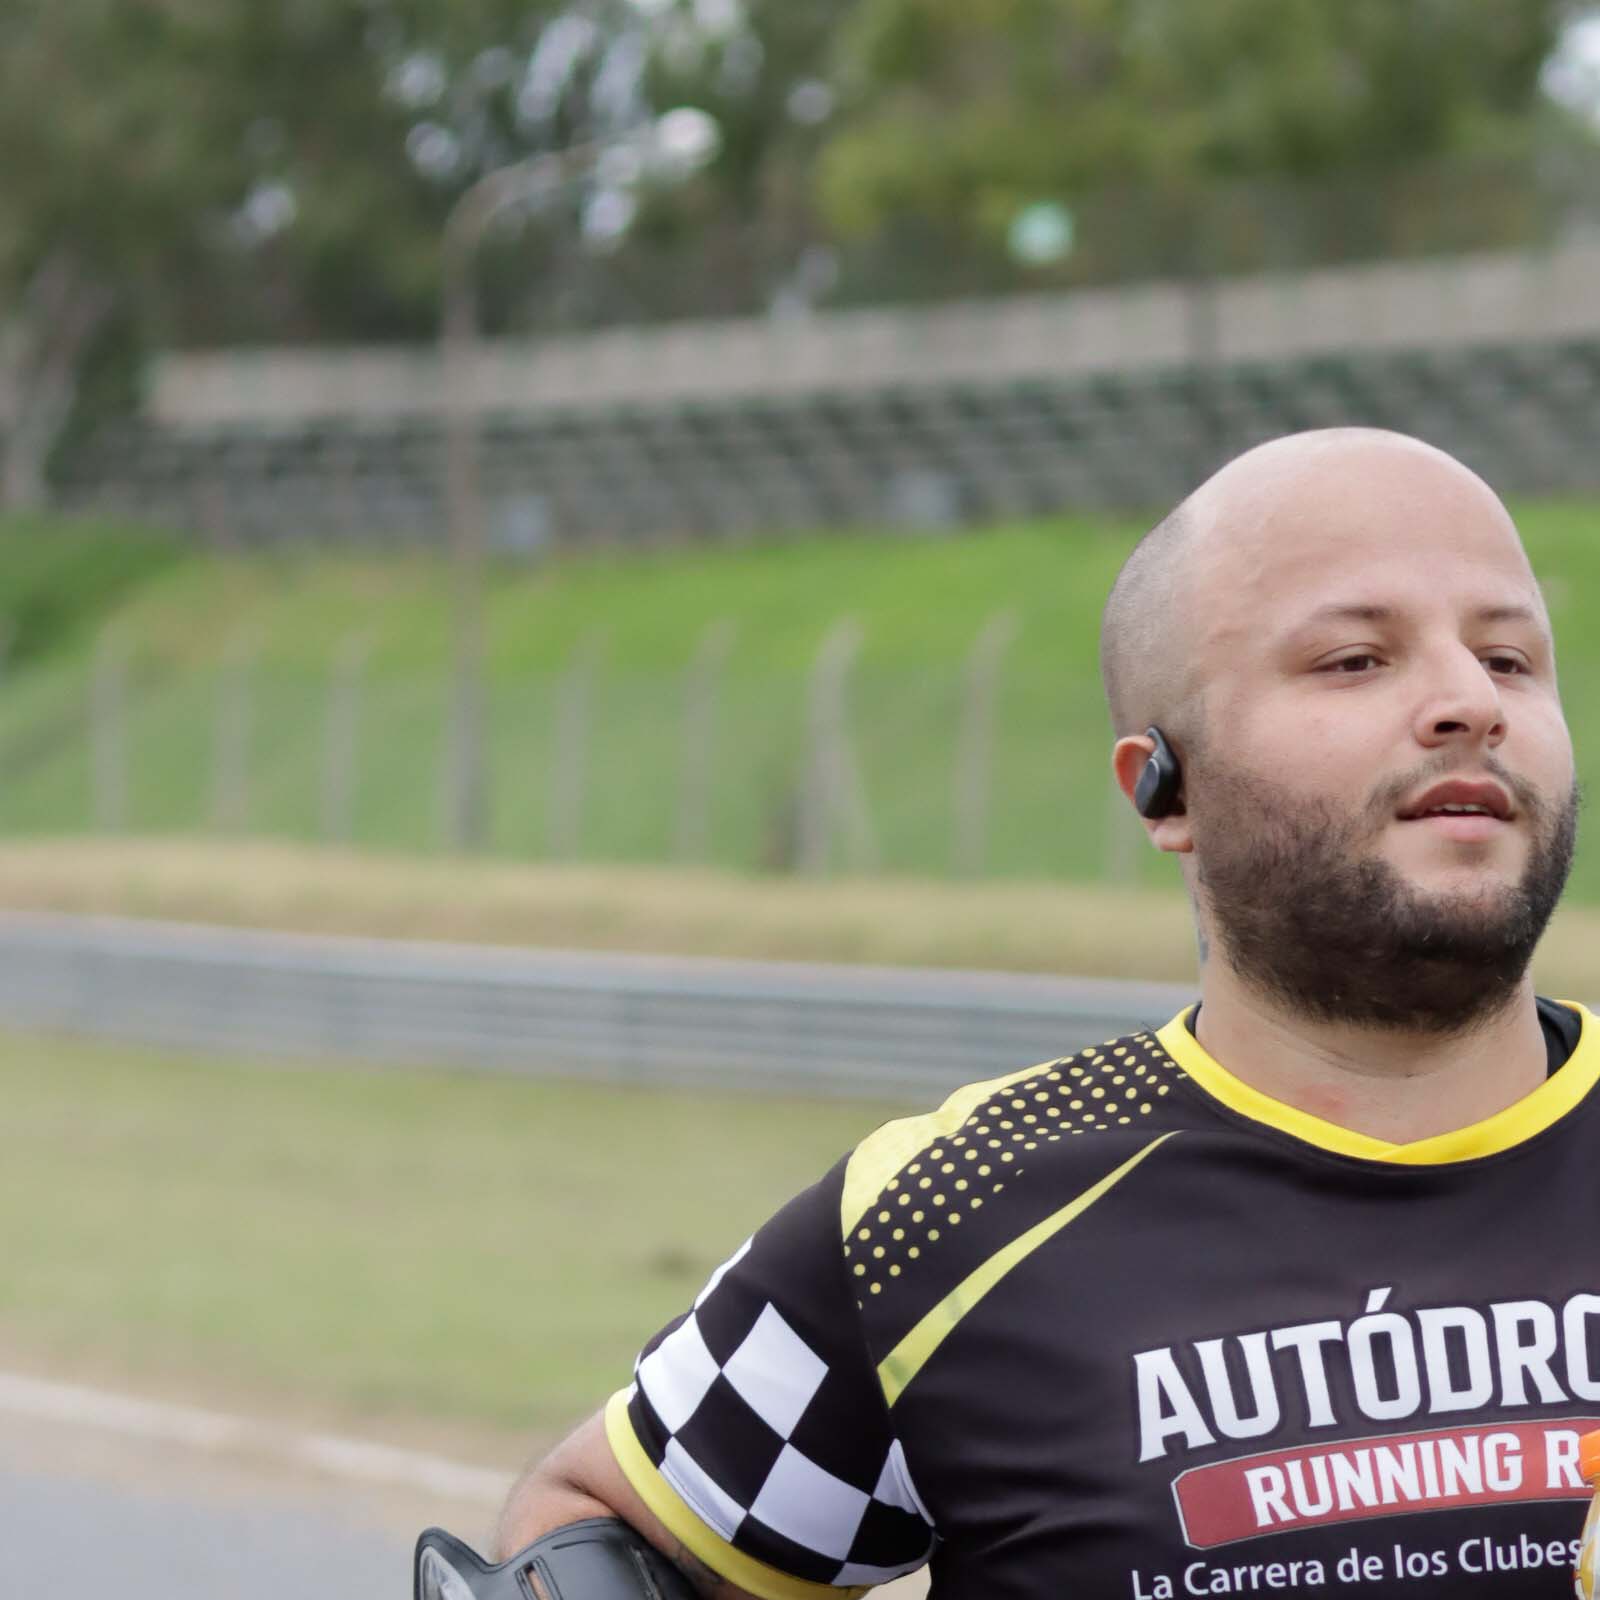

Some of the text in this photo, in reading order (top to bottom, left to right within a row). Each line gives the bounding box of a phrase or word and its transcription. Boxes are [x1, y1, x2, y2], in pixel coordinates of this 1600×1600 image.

[1244, 1432, 1523, 1528] RUNNING
[1183, 1559, 1326, 1596] Carrera
[1336, 1547, 1385, 1583] de
[1393, 1544, 1449, 1579] los
[1457, 1533, 1583, 1573] Clubes
